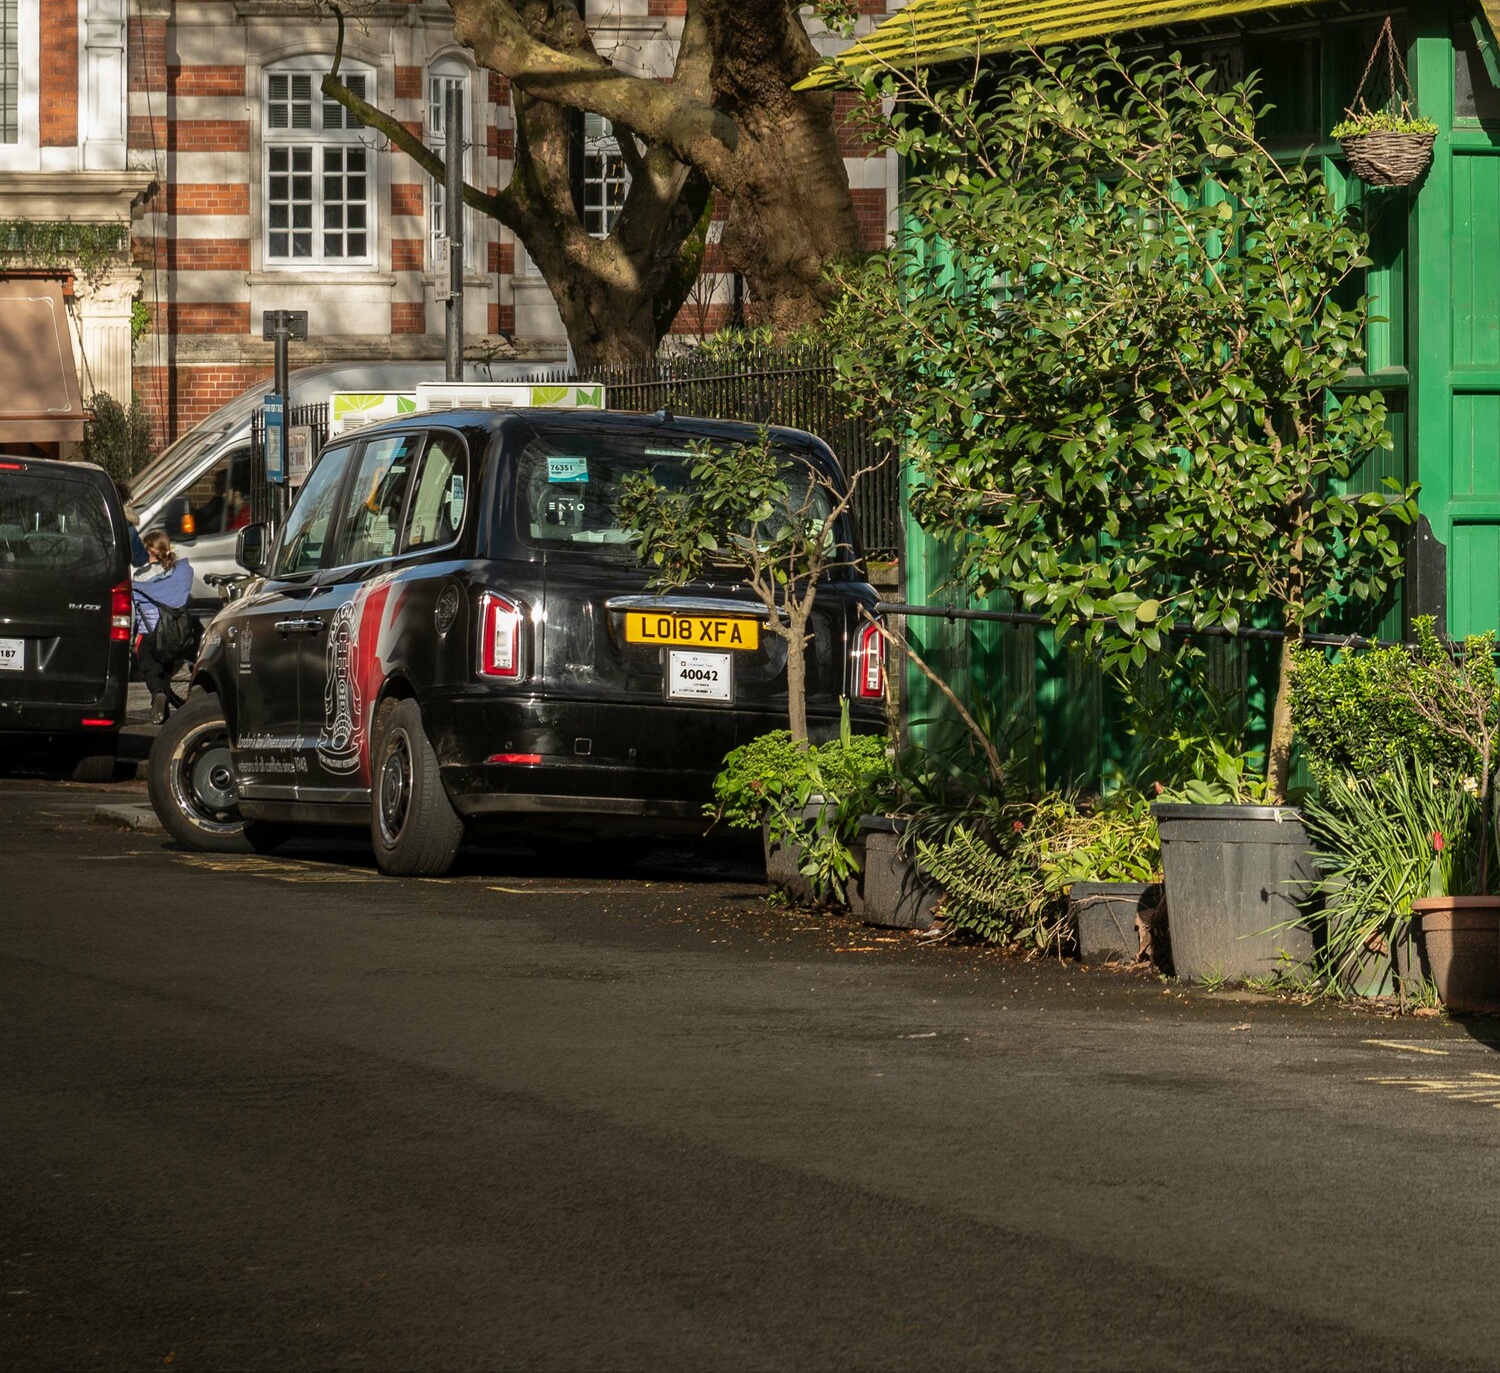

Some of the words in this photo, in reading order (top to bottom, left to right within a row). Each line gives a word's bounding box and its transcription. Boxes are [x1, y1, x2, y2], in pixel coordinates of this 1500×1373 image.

[550, 464, 573, 472] 76351
[548, 502, 585, 511] ENSO
[642, 617, 692, 640] LO18
[699, 620, 743, 644] XFA
[680, 669, 718, 682] 40042
